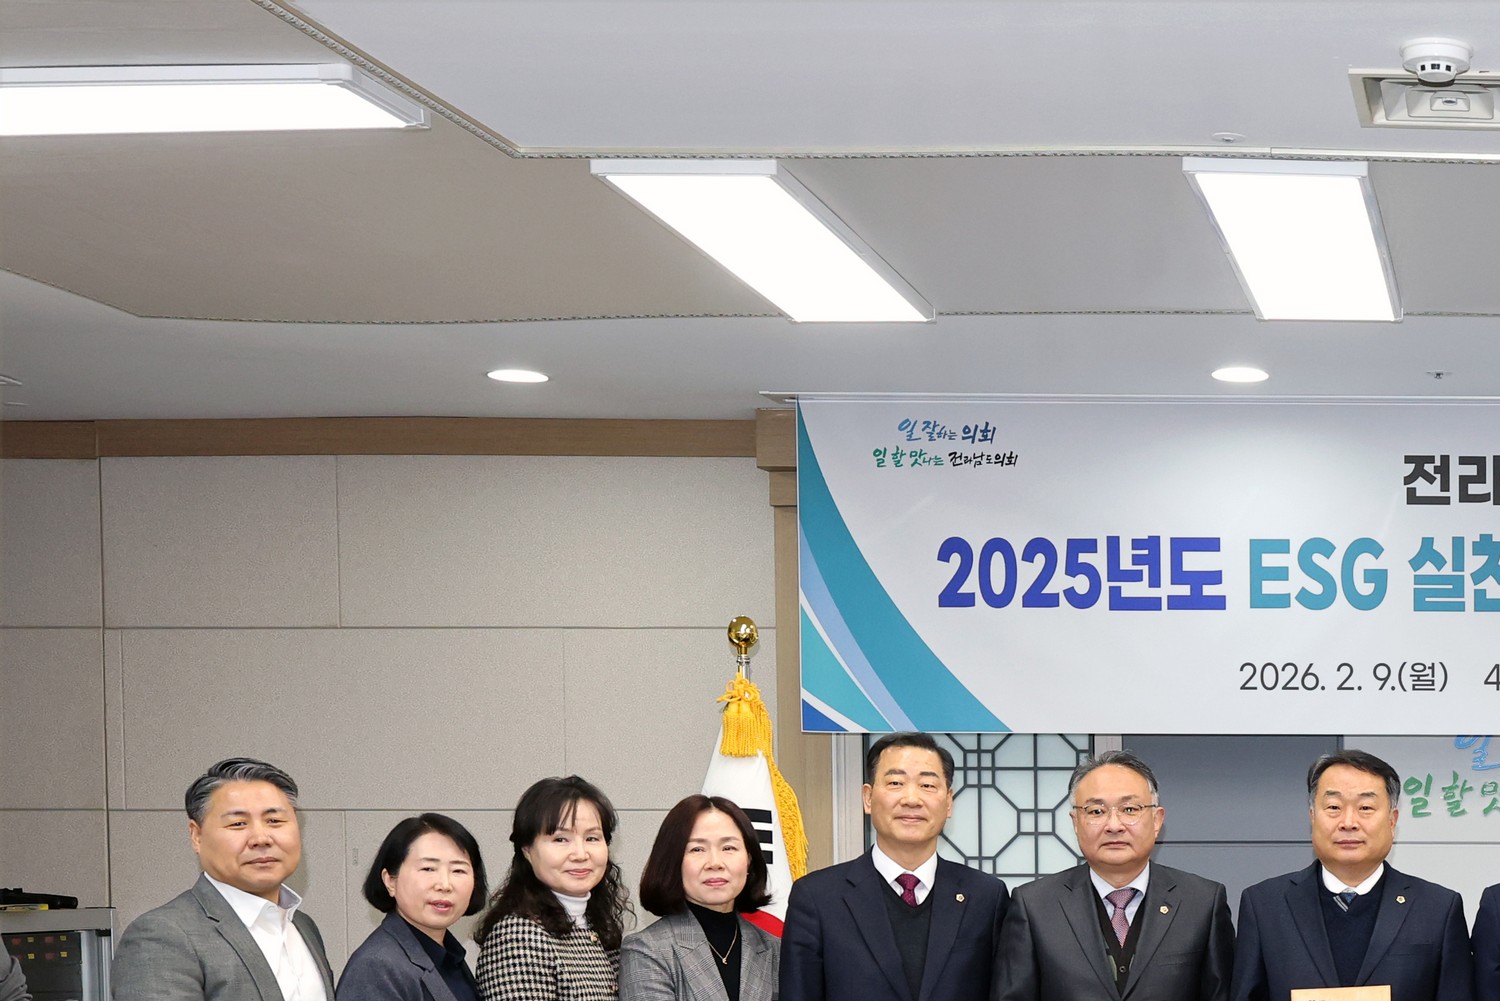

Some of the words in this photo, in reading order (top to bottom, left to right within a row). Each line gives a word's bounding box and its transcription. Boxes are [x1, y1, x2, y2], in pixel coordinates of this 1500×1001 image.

[898, 418, 921, 442] 일
[921, 420, 958, 442] 잘하는
[961, 421, 997, 444] 의회
[872, 447, 888, 468] 일
[890, 445, 906, 468] 할
[909, 449, 945, 468] 맛나는
[948, 450, 1018, 468] 전라남도의회
[936, 535, 1227, 612] 2025년도
[1248, 536, 1389, 612] ESG
[1239, 661, 1326, 692] 2026.
[1336, 662, 1363, 692] 2.
[1373, 661, 1449, 693] 9.(월)
[1403, 772, 1433, 818] 일
[1442, 770, 1473, 817] 할
